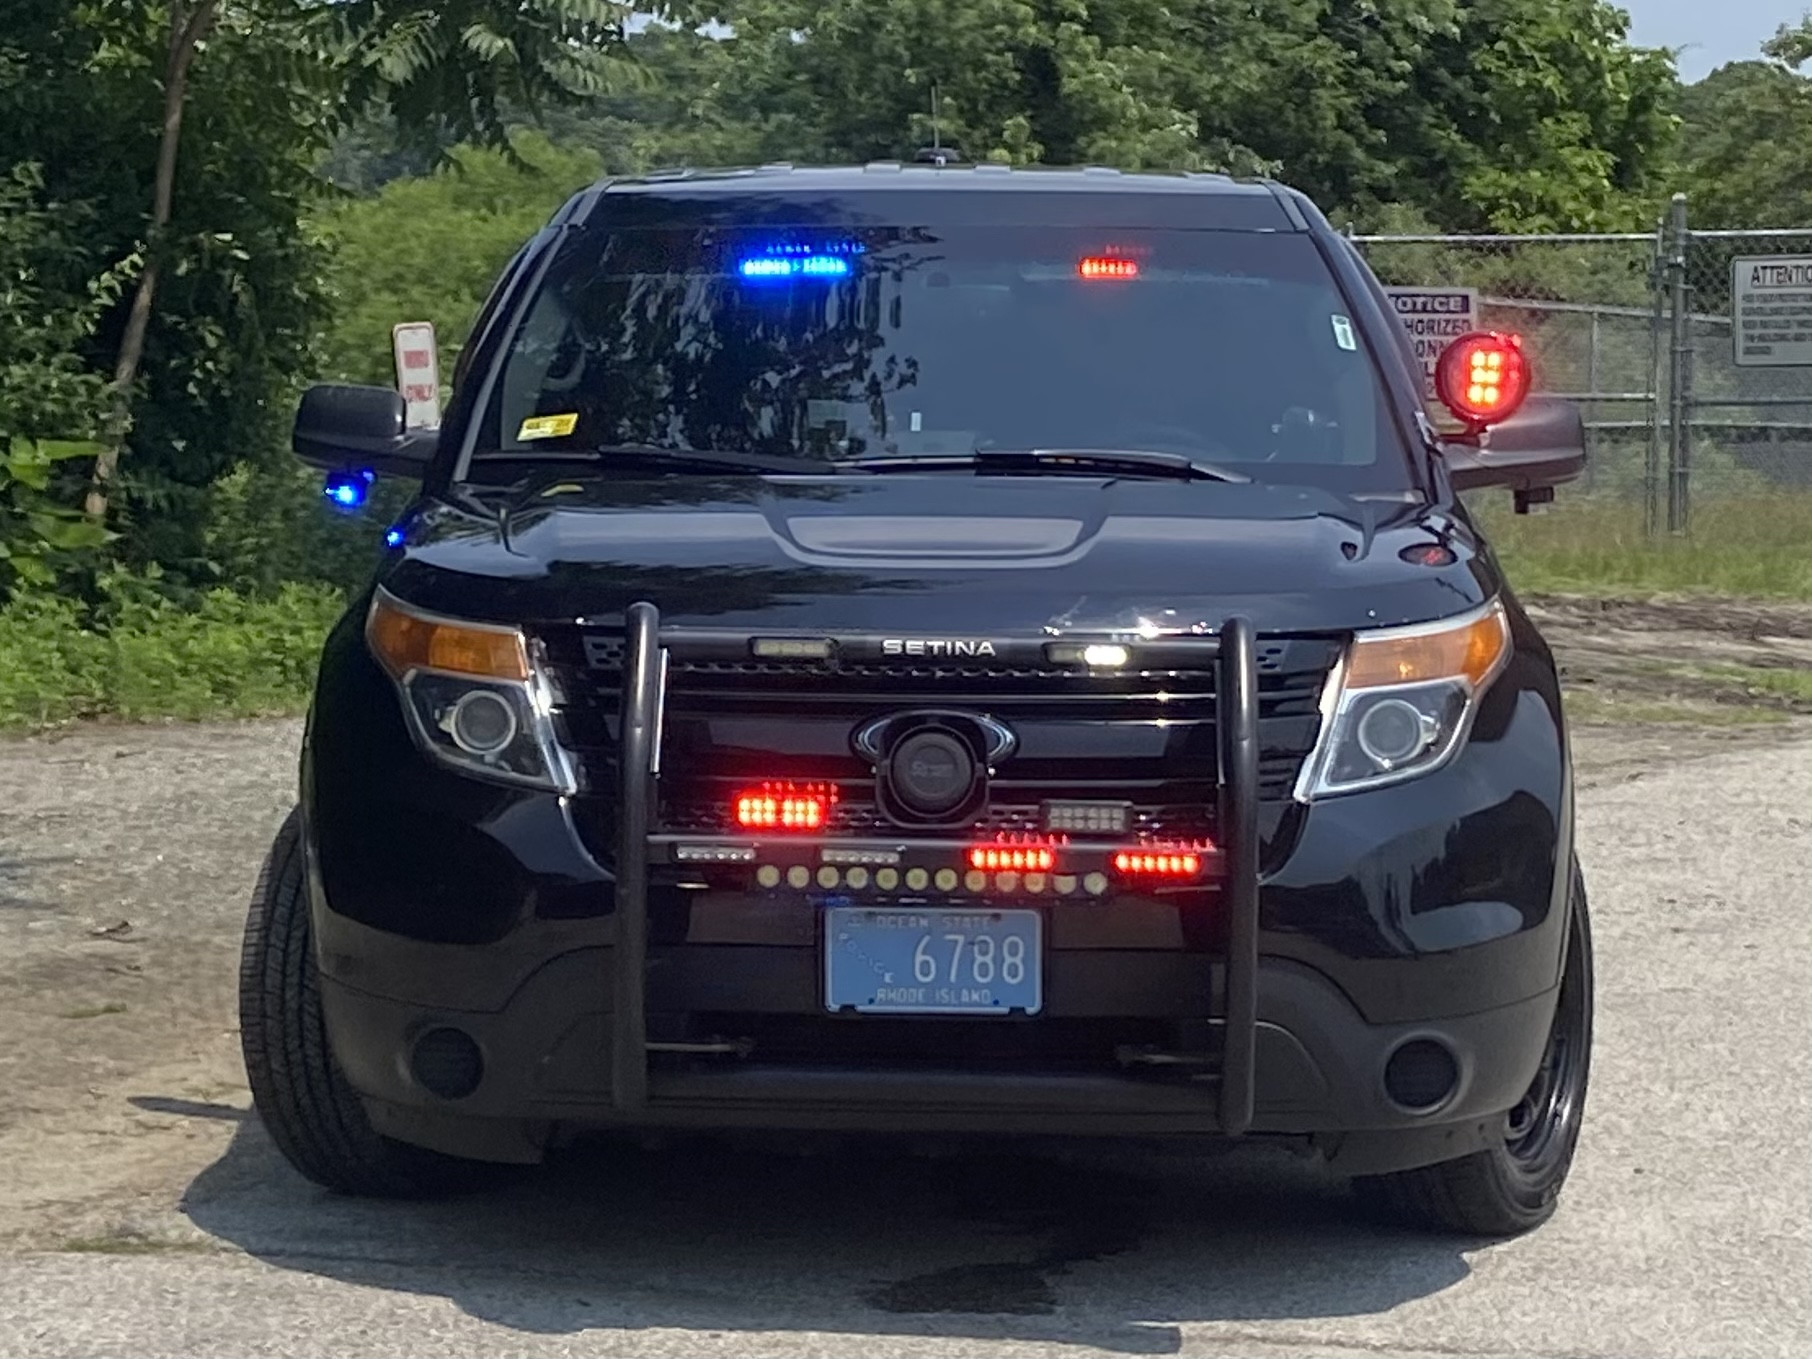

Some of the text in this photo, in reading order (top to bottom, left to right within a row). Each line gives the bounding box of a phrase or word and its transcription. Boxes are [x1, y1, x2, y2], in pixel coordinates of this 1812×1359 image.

[1752, 265, 1812, 285] ATTENTIO
[1403, 319, 1472, 336] HORIZED
[882, 639, 996, 657] SETINA
[876, 915, 991, 929] OCEAN STATE
[914, 934, 1025, 984] 6788
[876, 988, 991, 1005] RHODE ISLAND
